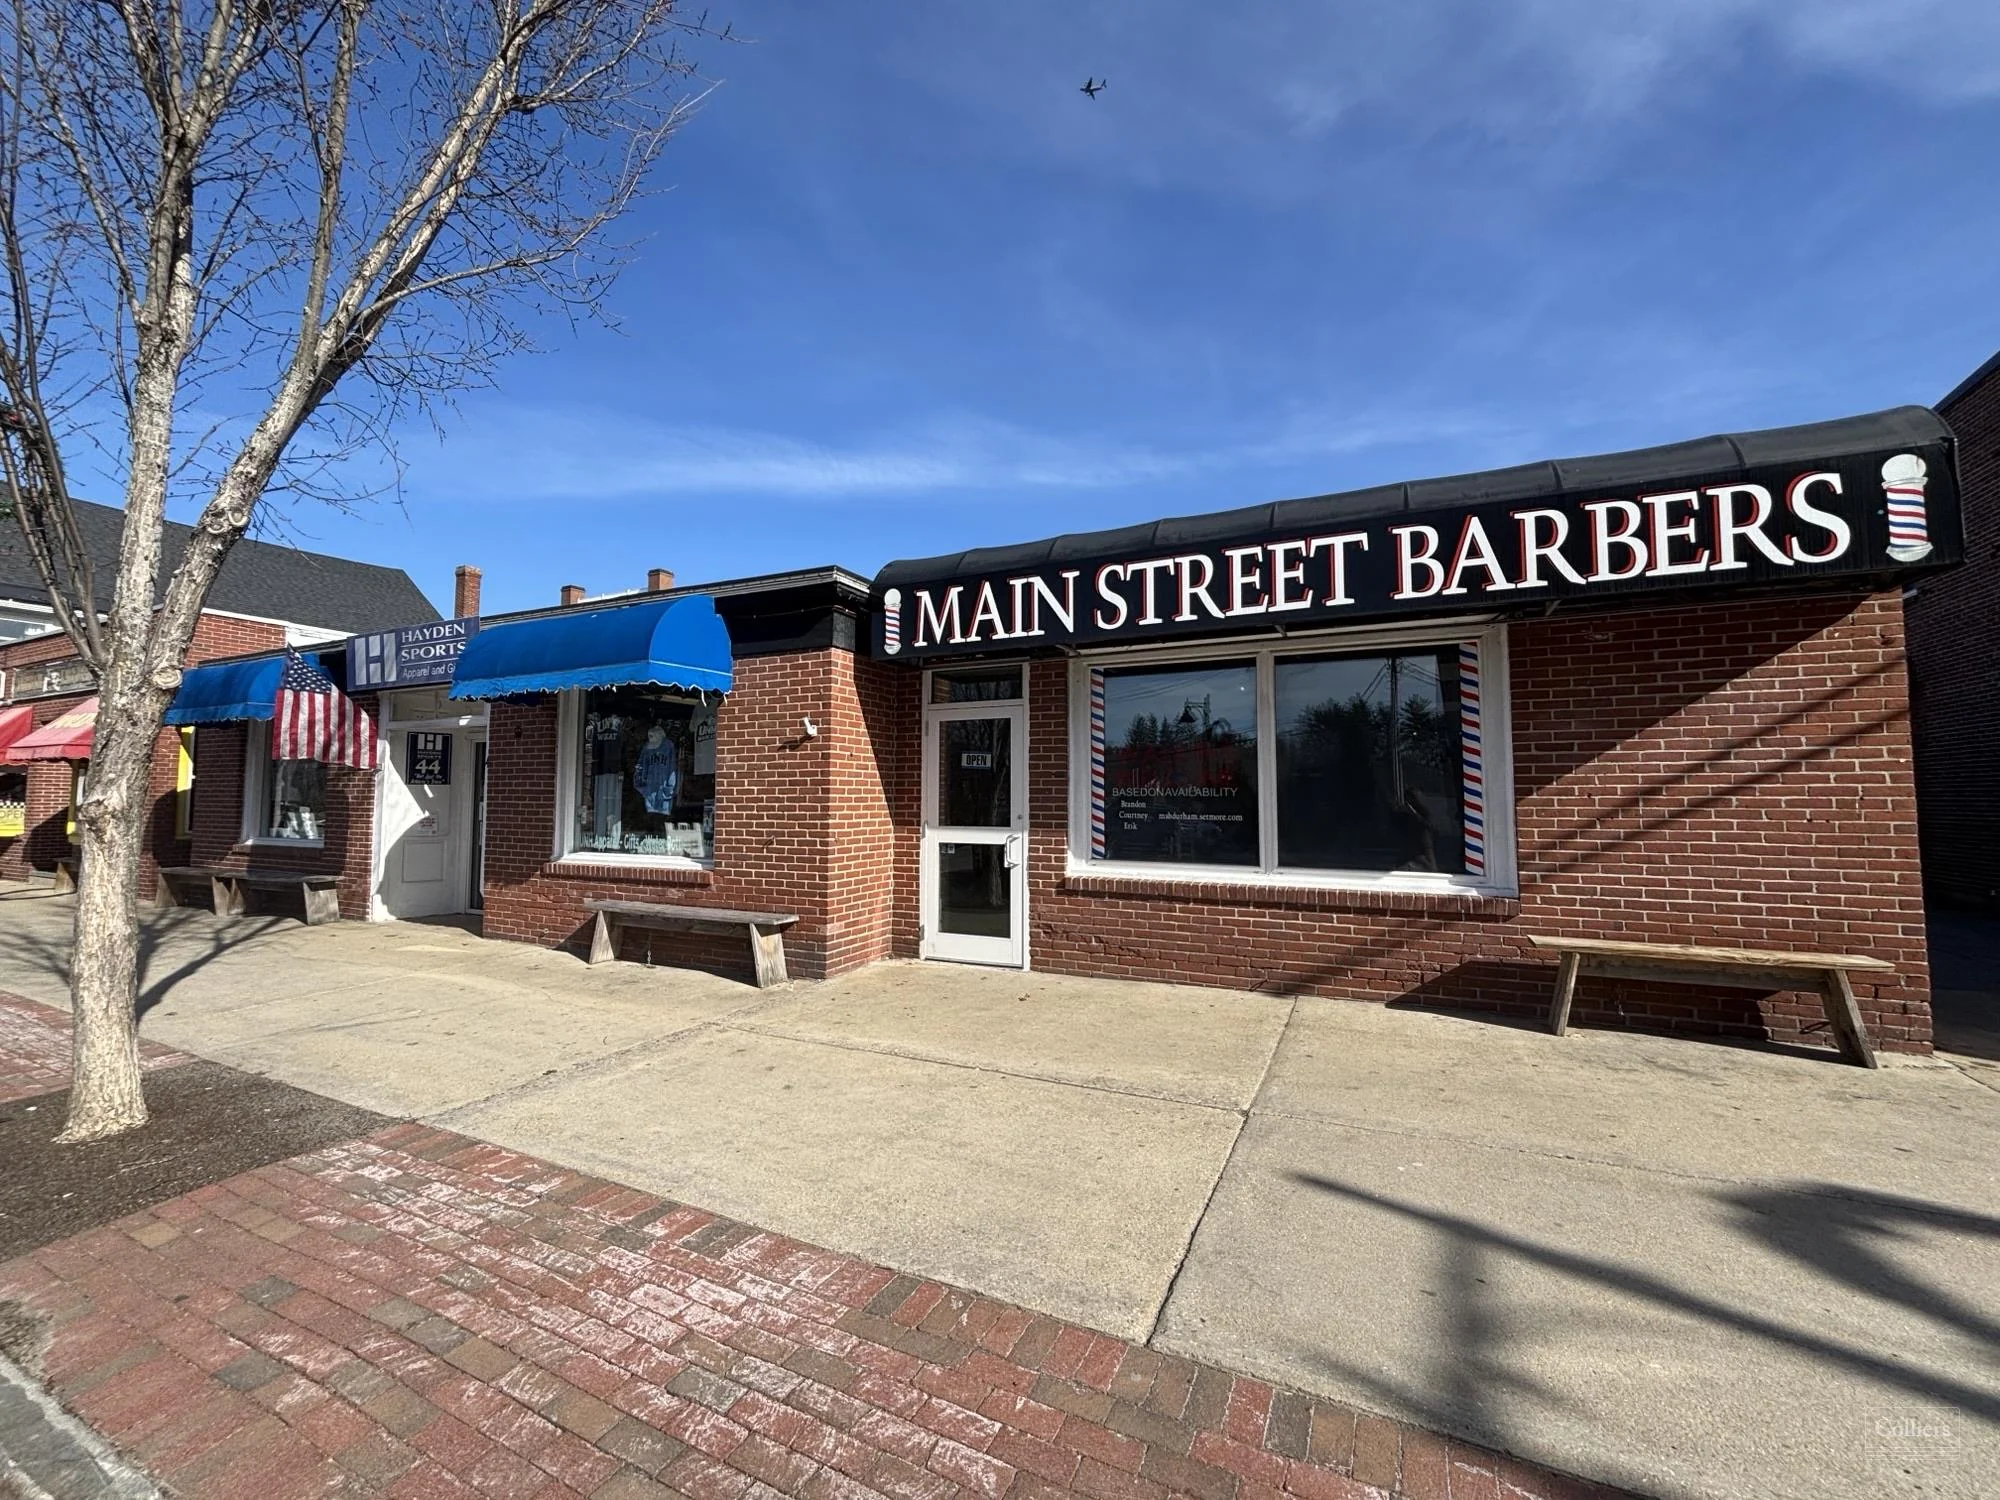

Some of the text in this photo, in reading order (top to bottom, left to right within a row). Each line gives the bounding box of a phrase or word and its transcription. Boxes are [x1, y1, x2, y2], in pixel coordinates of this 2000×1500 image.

[914, 470, 1851, 648] MAIN STREET BARBERS
[402, 622, 465, 643] HAYDEN
[354, 632, 397, 685] H
[401, 641, 467, 662] SPORTS
[402, 662, 456, 679] Apparel and Gi
[415, 759, 441, 774] 44
[966, 754, 987, 766] OPEN
[1120, 800, 1147, 809] Brandon
[1118, 810, 1149, 823] Courtney
[1123, 822, 1138, 830] Erik
